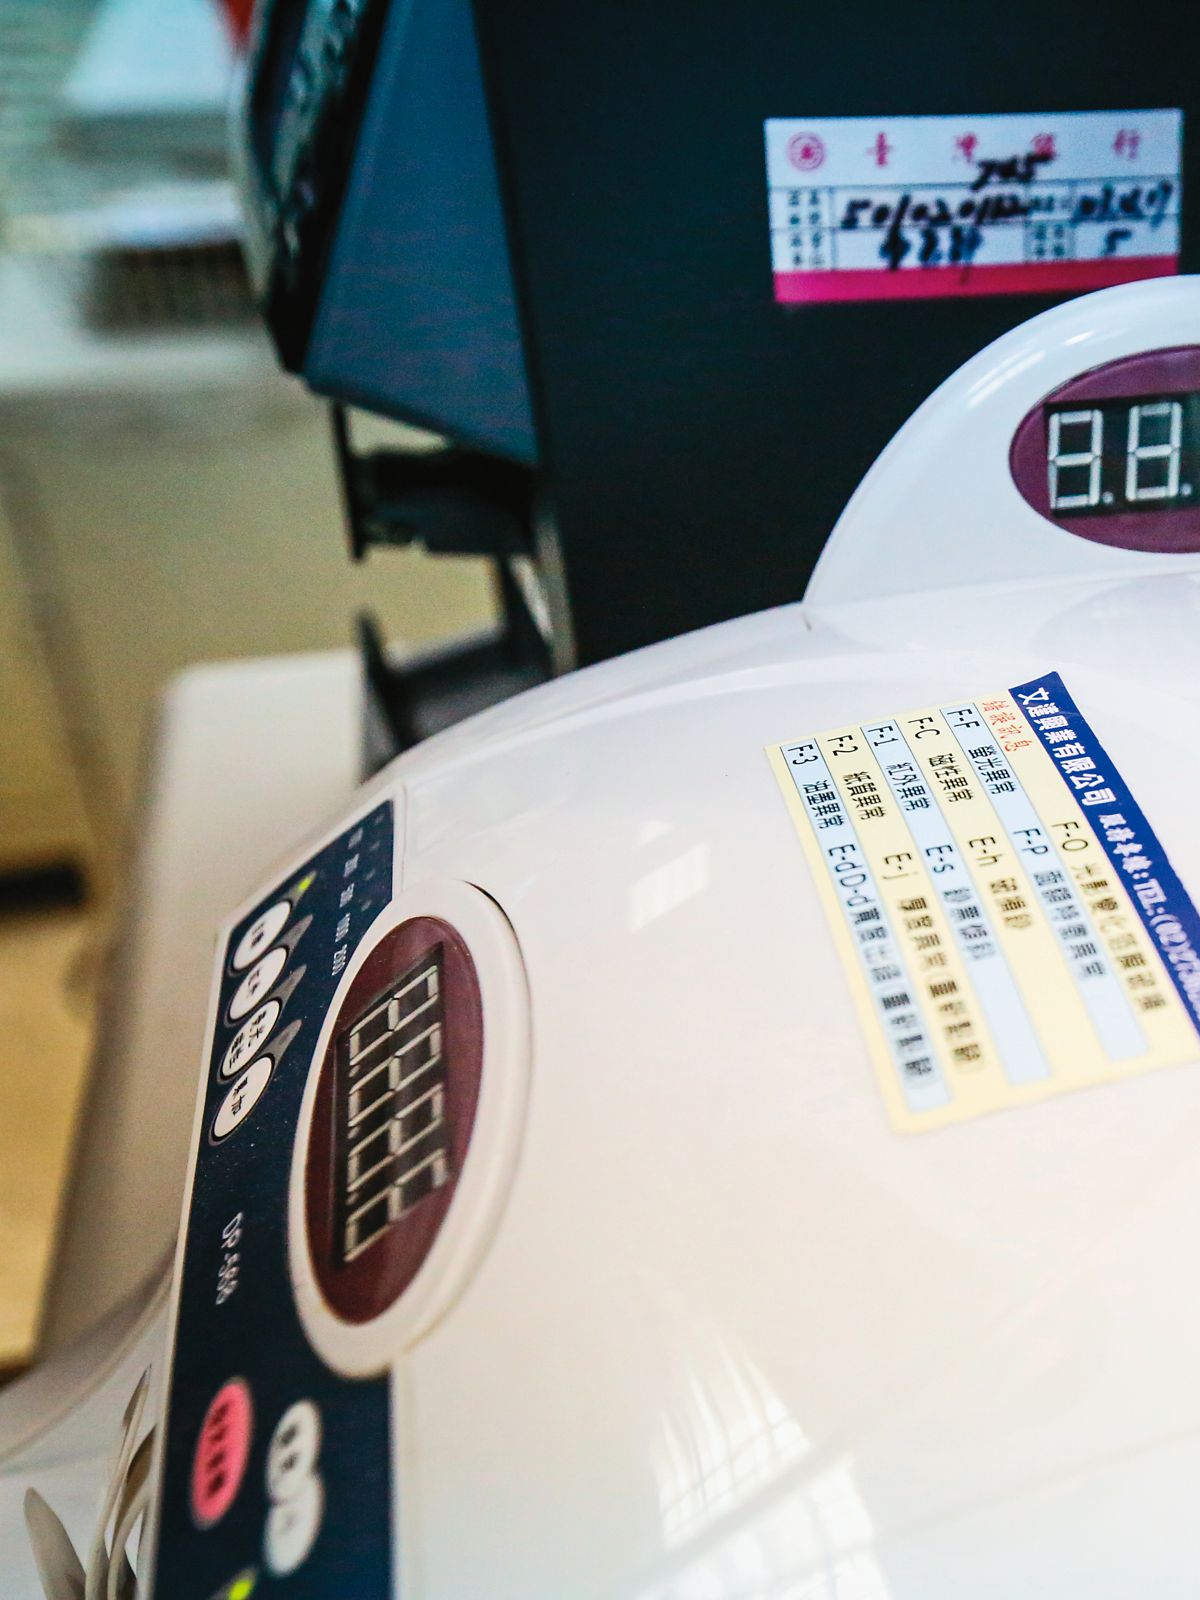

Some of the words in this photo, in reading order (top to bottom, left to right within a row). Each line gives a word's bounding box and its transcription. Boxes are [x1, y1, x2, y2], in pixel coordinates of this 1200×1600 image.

[787, 744, 818, 765] F-3
[981, 700, 1032, 752] 錯誤訊息
[1017, 687, 1116, 806] 文達興業有限公司
[802, 779, 844, 829] 油墨異常
[826, 734, 858, 756] F-2
[842, 771, 885, 820] 紙質異常
[885, 762, 930, 811] 紅外異常
[924, 844, 954, 873] E-s
[907, 716, 940, 739] F-C
[928, 753, 973, 802] 磁性異常
[967, 836, 1001, 866] E-h
[946, 708, 980, 728] F-F
[967, 744, 1015, 794] 螢光異常
[1013, 828, 1048, 855] F-P
